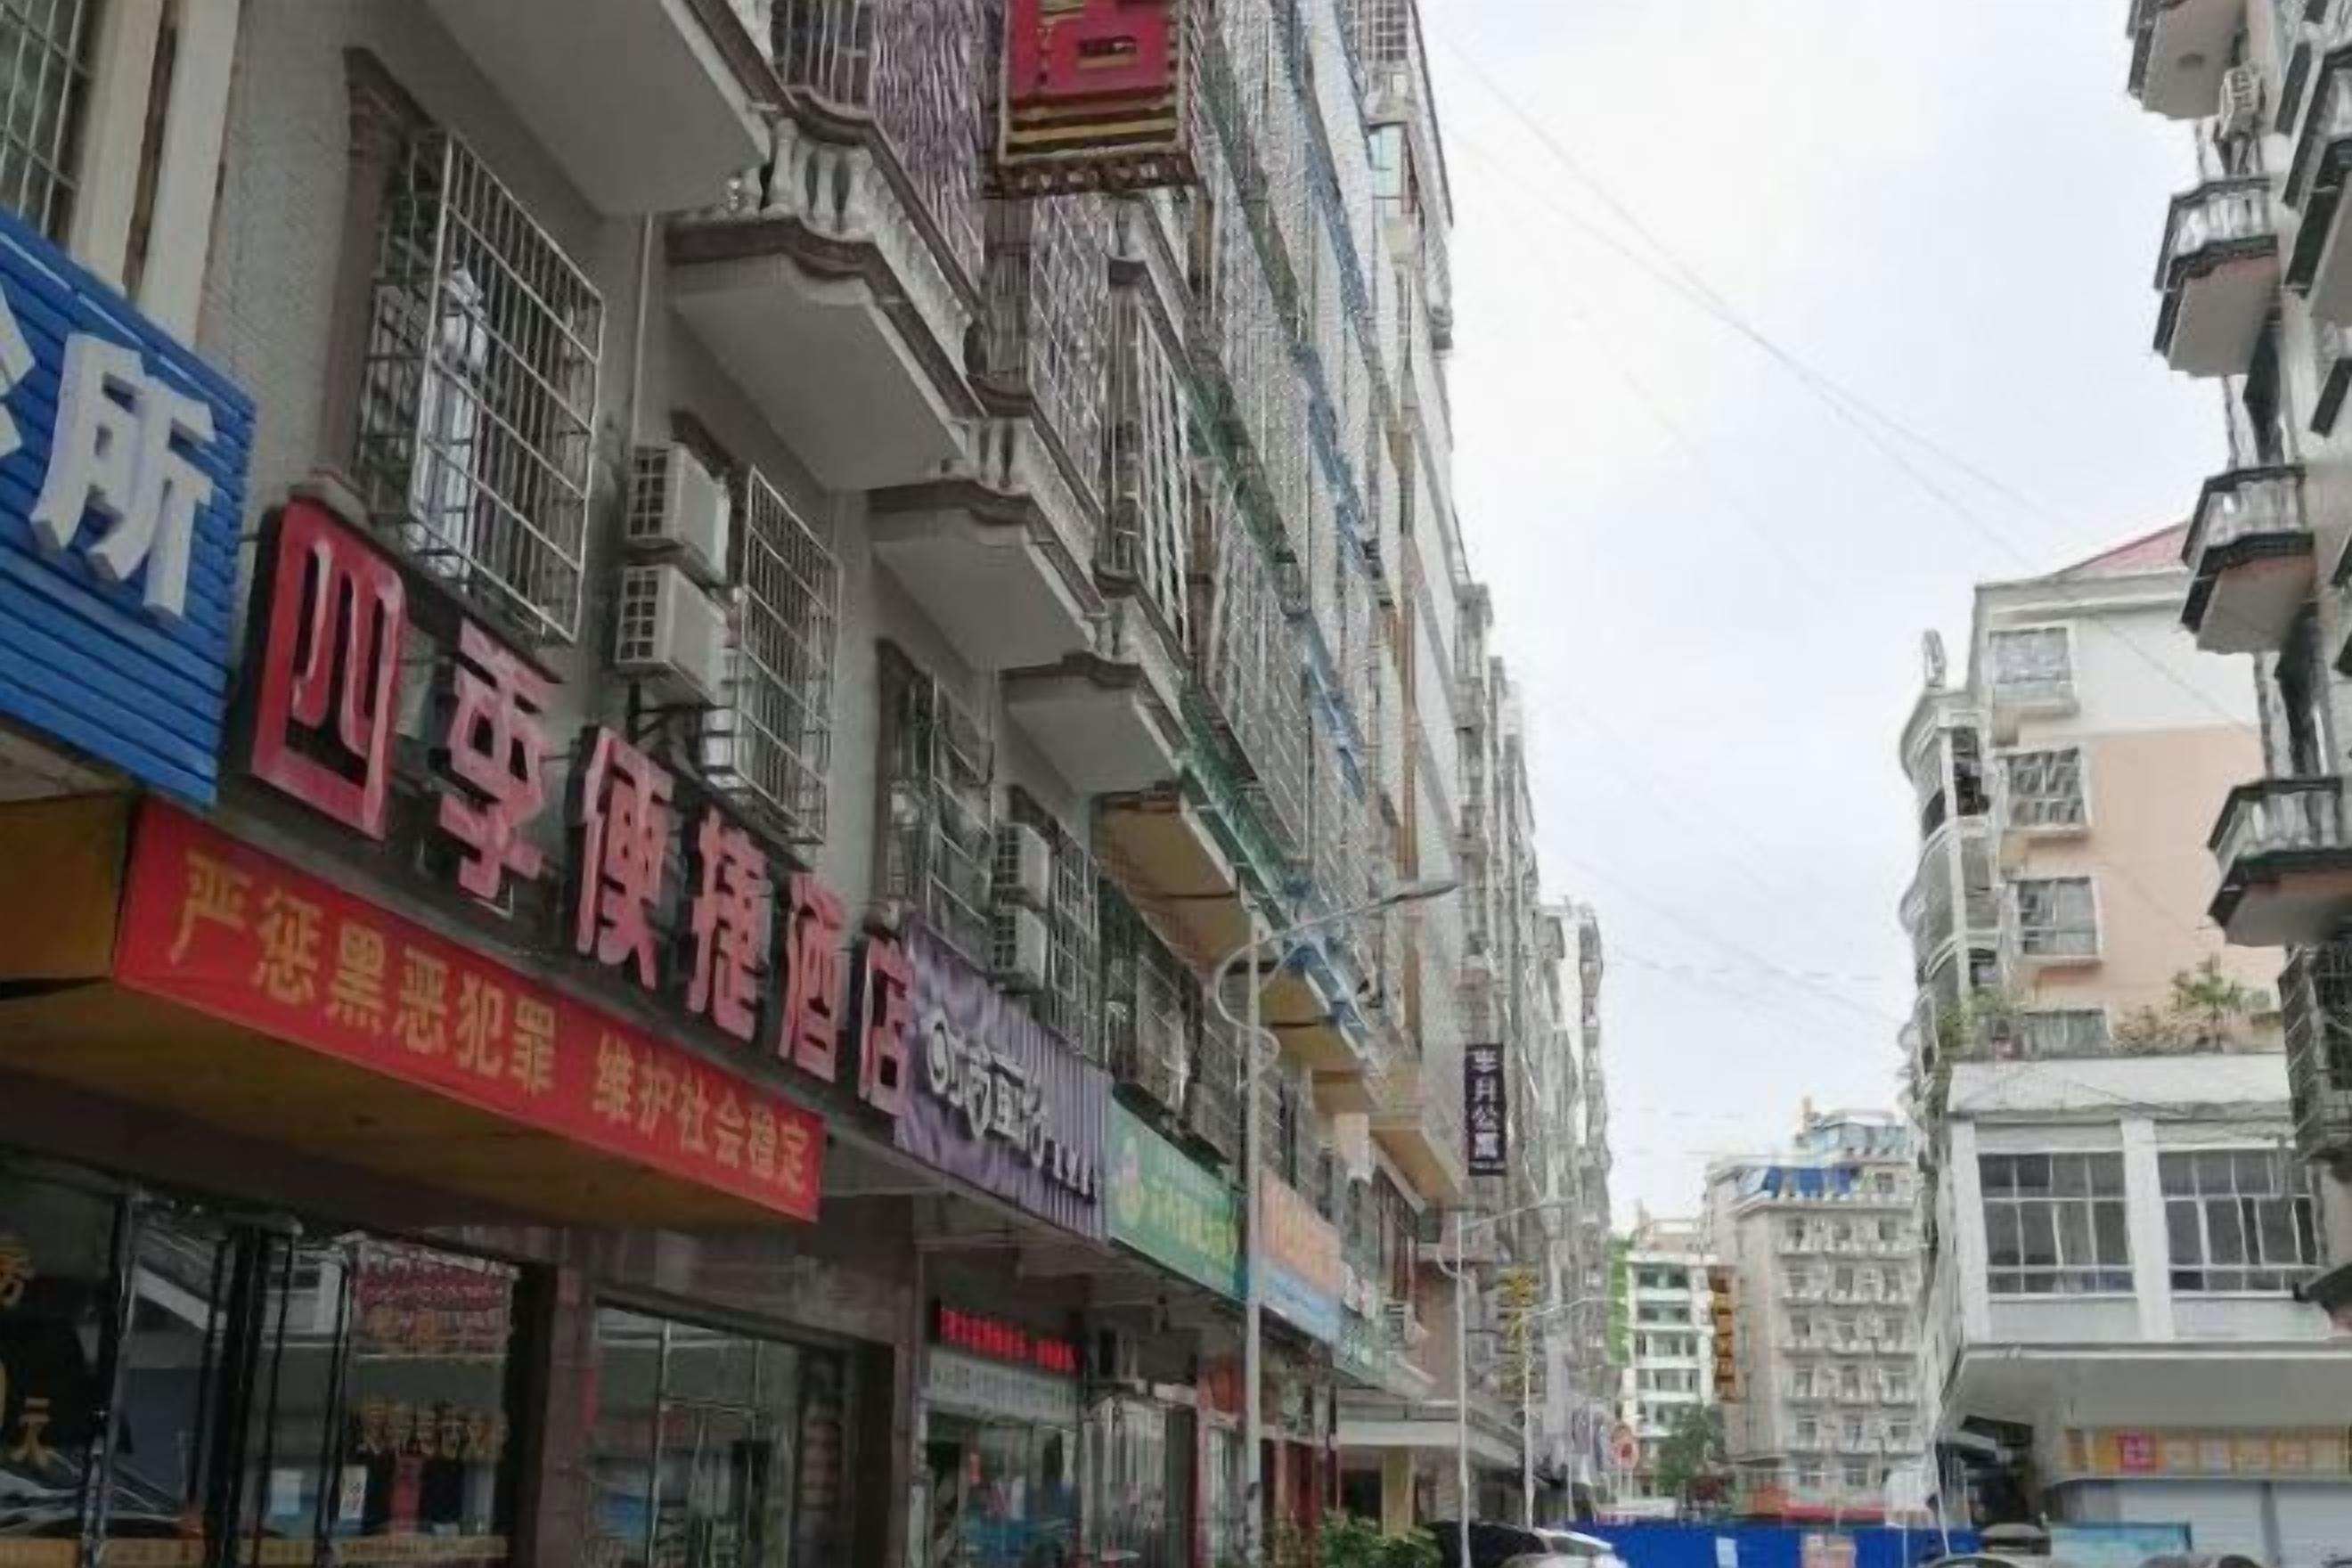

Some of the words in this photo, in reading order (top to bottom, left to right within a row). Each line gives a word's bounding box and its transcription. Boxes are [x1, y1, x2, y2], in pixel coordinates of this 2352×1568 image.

[169, 848, 557, 1097] 严惩黑恶犯罪
[592, 1028, 811, 1196] 维护社会稳定
[251, 497, 911, 1115] 四季便捷酒店
